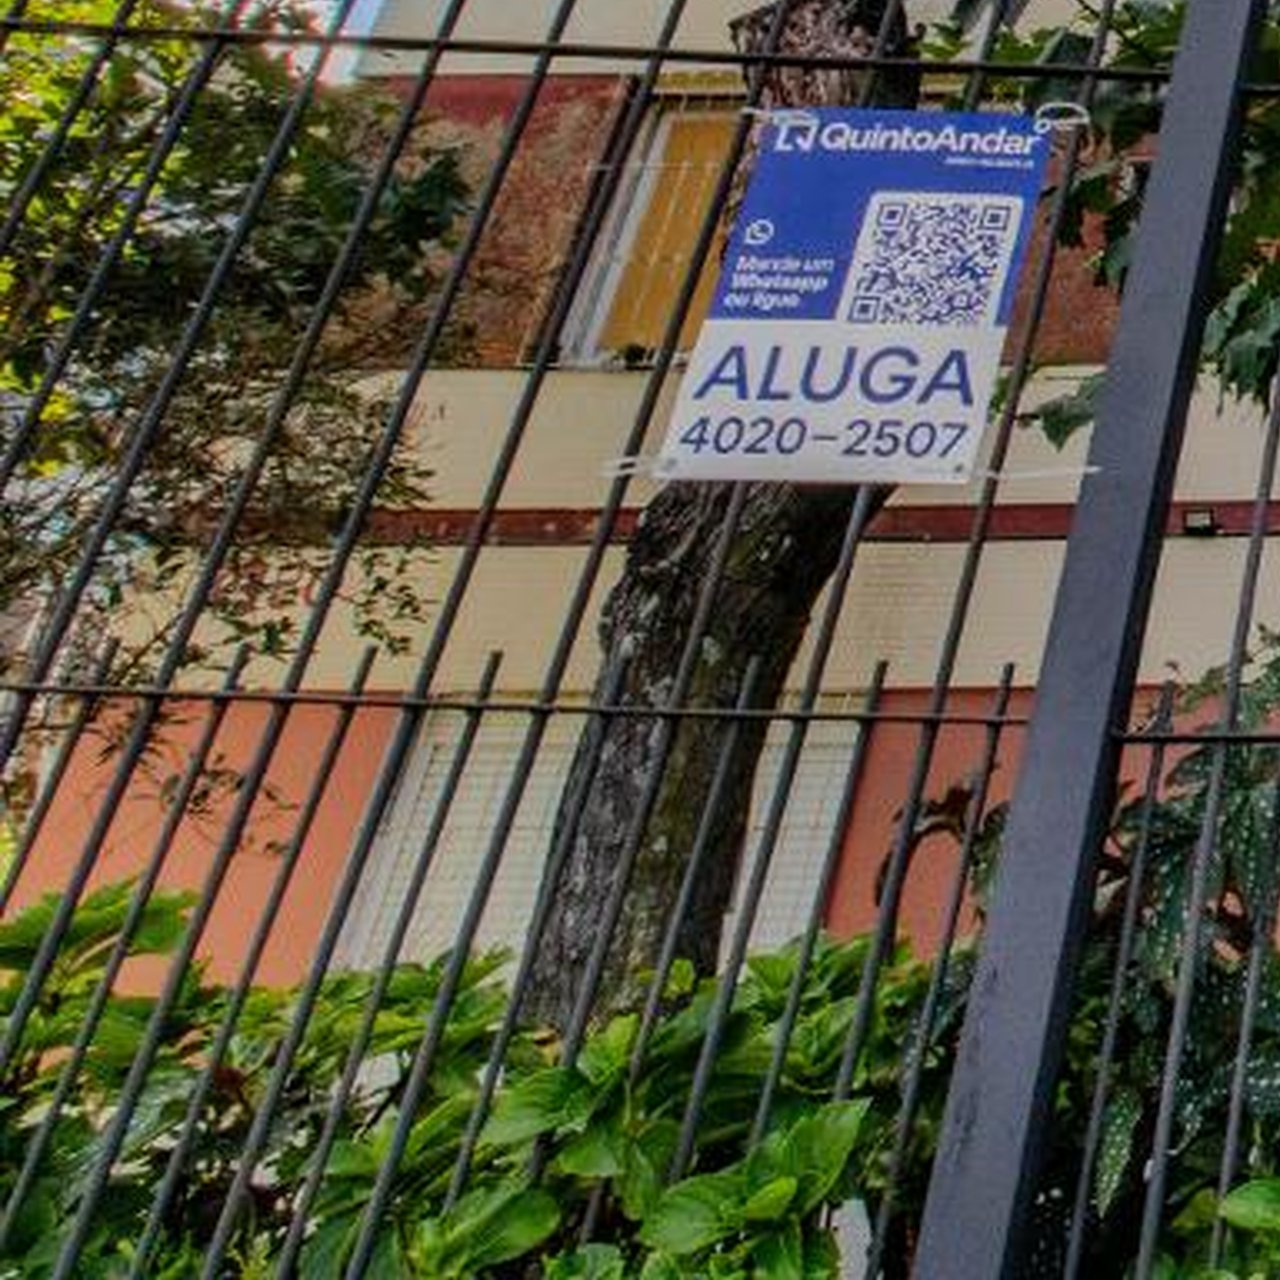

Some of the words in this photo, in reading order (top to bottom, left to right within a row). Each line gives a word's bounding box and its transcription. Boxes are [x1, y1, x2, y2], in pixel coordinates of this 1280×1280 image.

[820, 122, 1039, 154] QuintoAndar
[693, 344, 973, 406] ALUGA
[679, 416, 967, 457] 4020-2507
